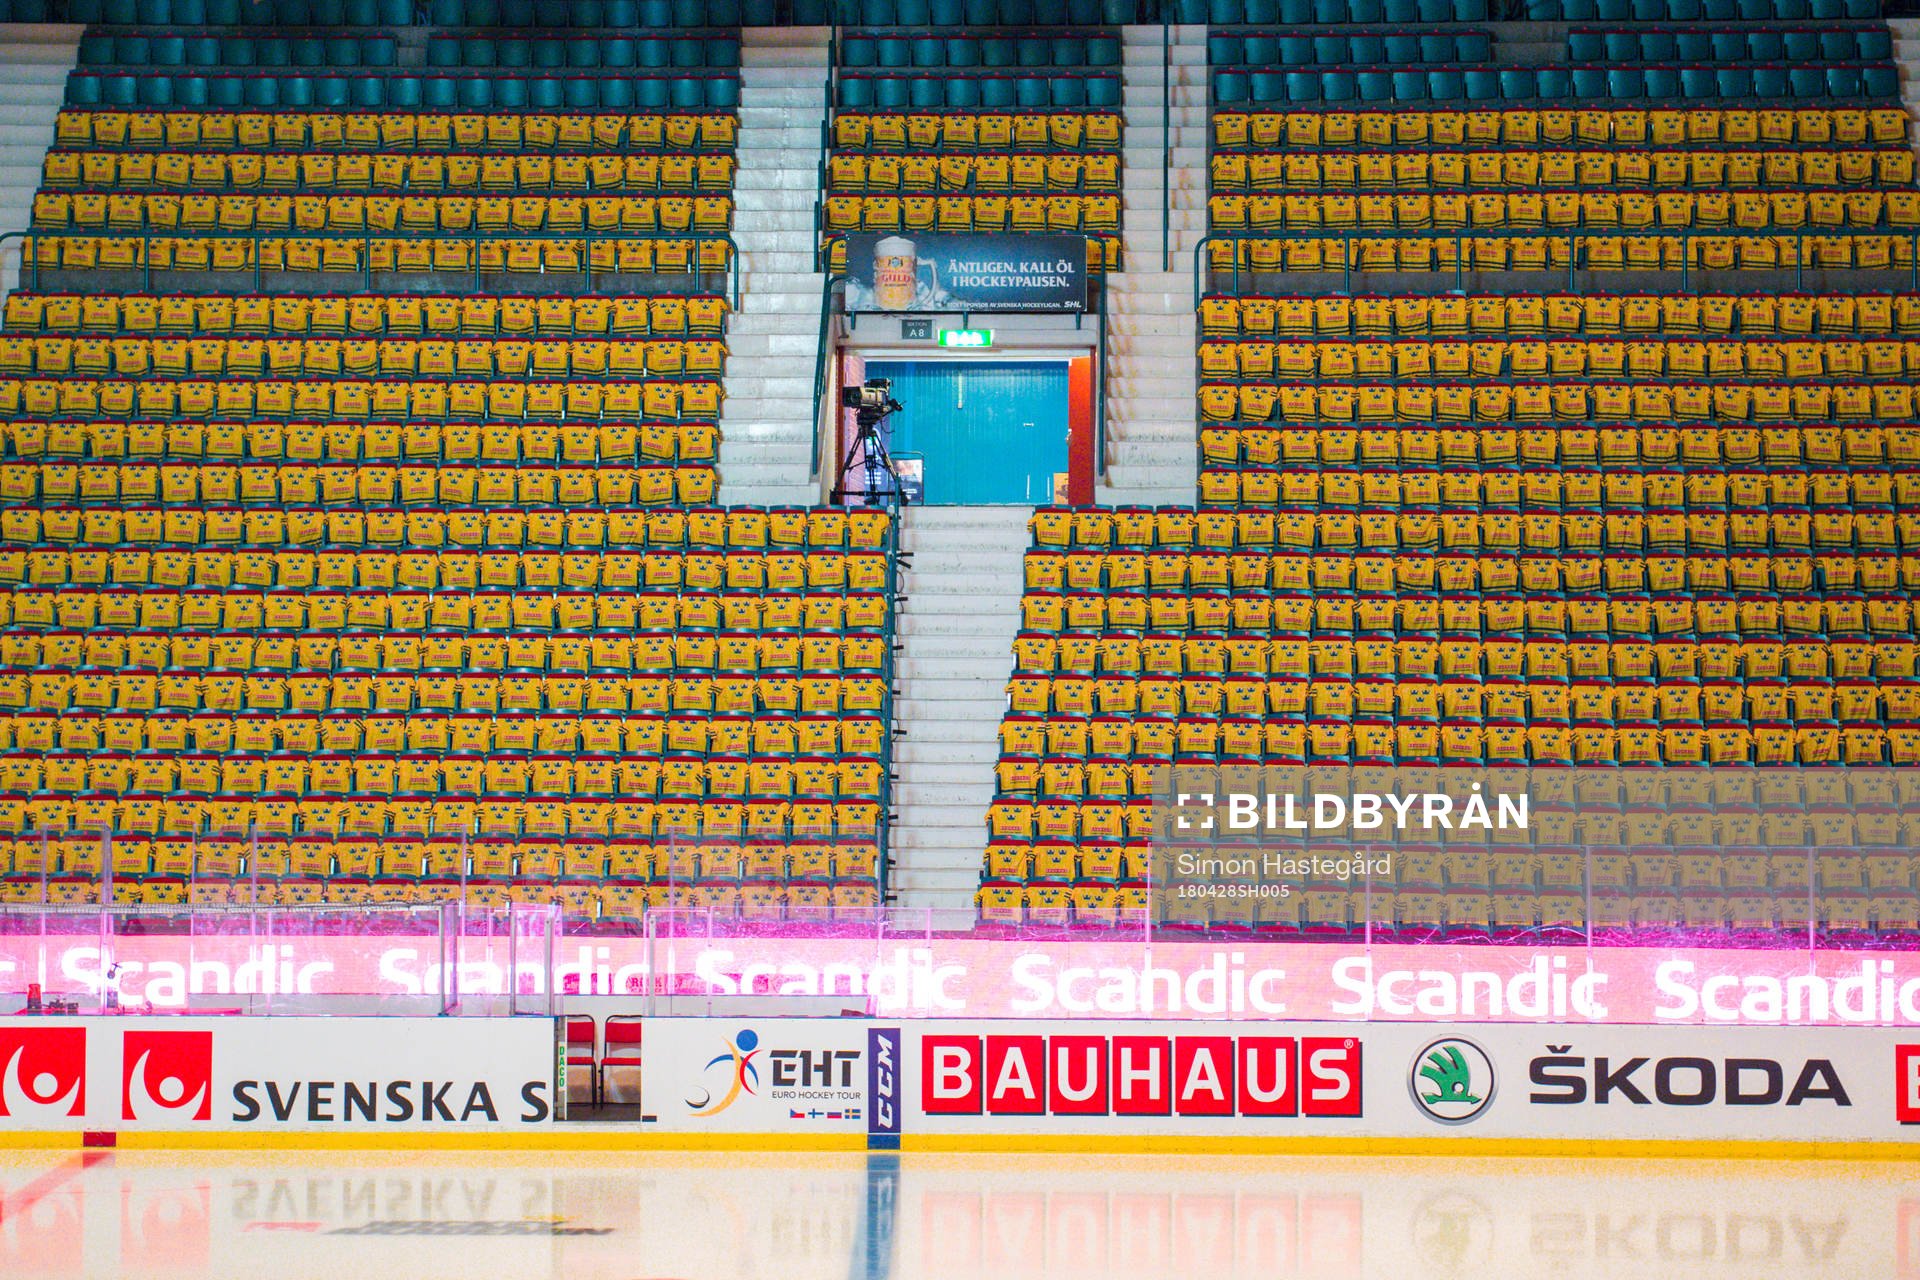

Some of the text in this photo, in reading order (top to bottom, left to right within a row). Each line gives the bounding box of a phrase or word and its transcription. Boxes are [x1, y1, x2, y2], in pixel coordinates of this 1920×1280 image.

[881, 274, 911, 282] GULD
[948, 259, 1075, 273] ÄNTLIGEN. KALL ÖL
[952, 276, 1070, 287] I HOCKEYPAUSEN.
[1063, 300, 1082, 308] SHL
[909, 328, 925, 337] A 8
[61, 944, 334, 1006] Scandic
[695, 948, 967, 1010] Scandic
[1011, 952, 1286, 1013] Scandic
[1331, 956, 1609, 1016] Scandic
[769, 1050, 861, 1087] EHT
[878, 1034, 893, 1128] CCM
[932, 1046, 1351, 1101] BAUHAUS
[1530, 1045, 1852, 1106] ŠKODA
[232, 1080, 499, 1122] SVENSKA
[772, 1091, 861, 1099] EURO HOCKEY TOUR
